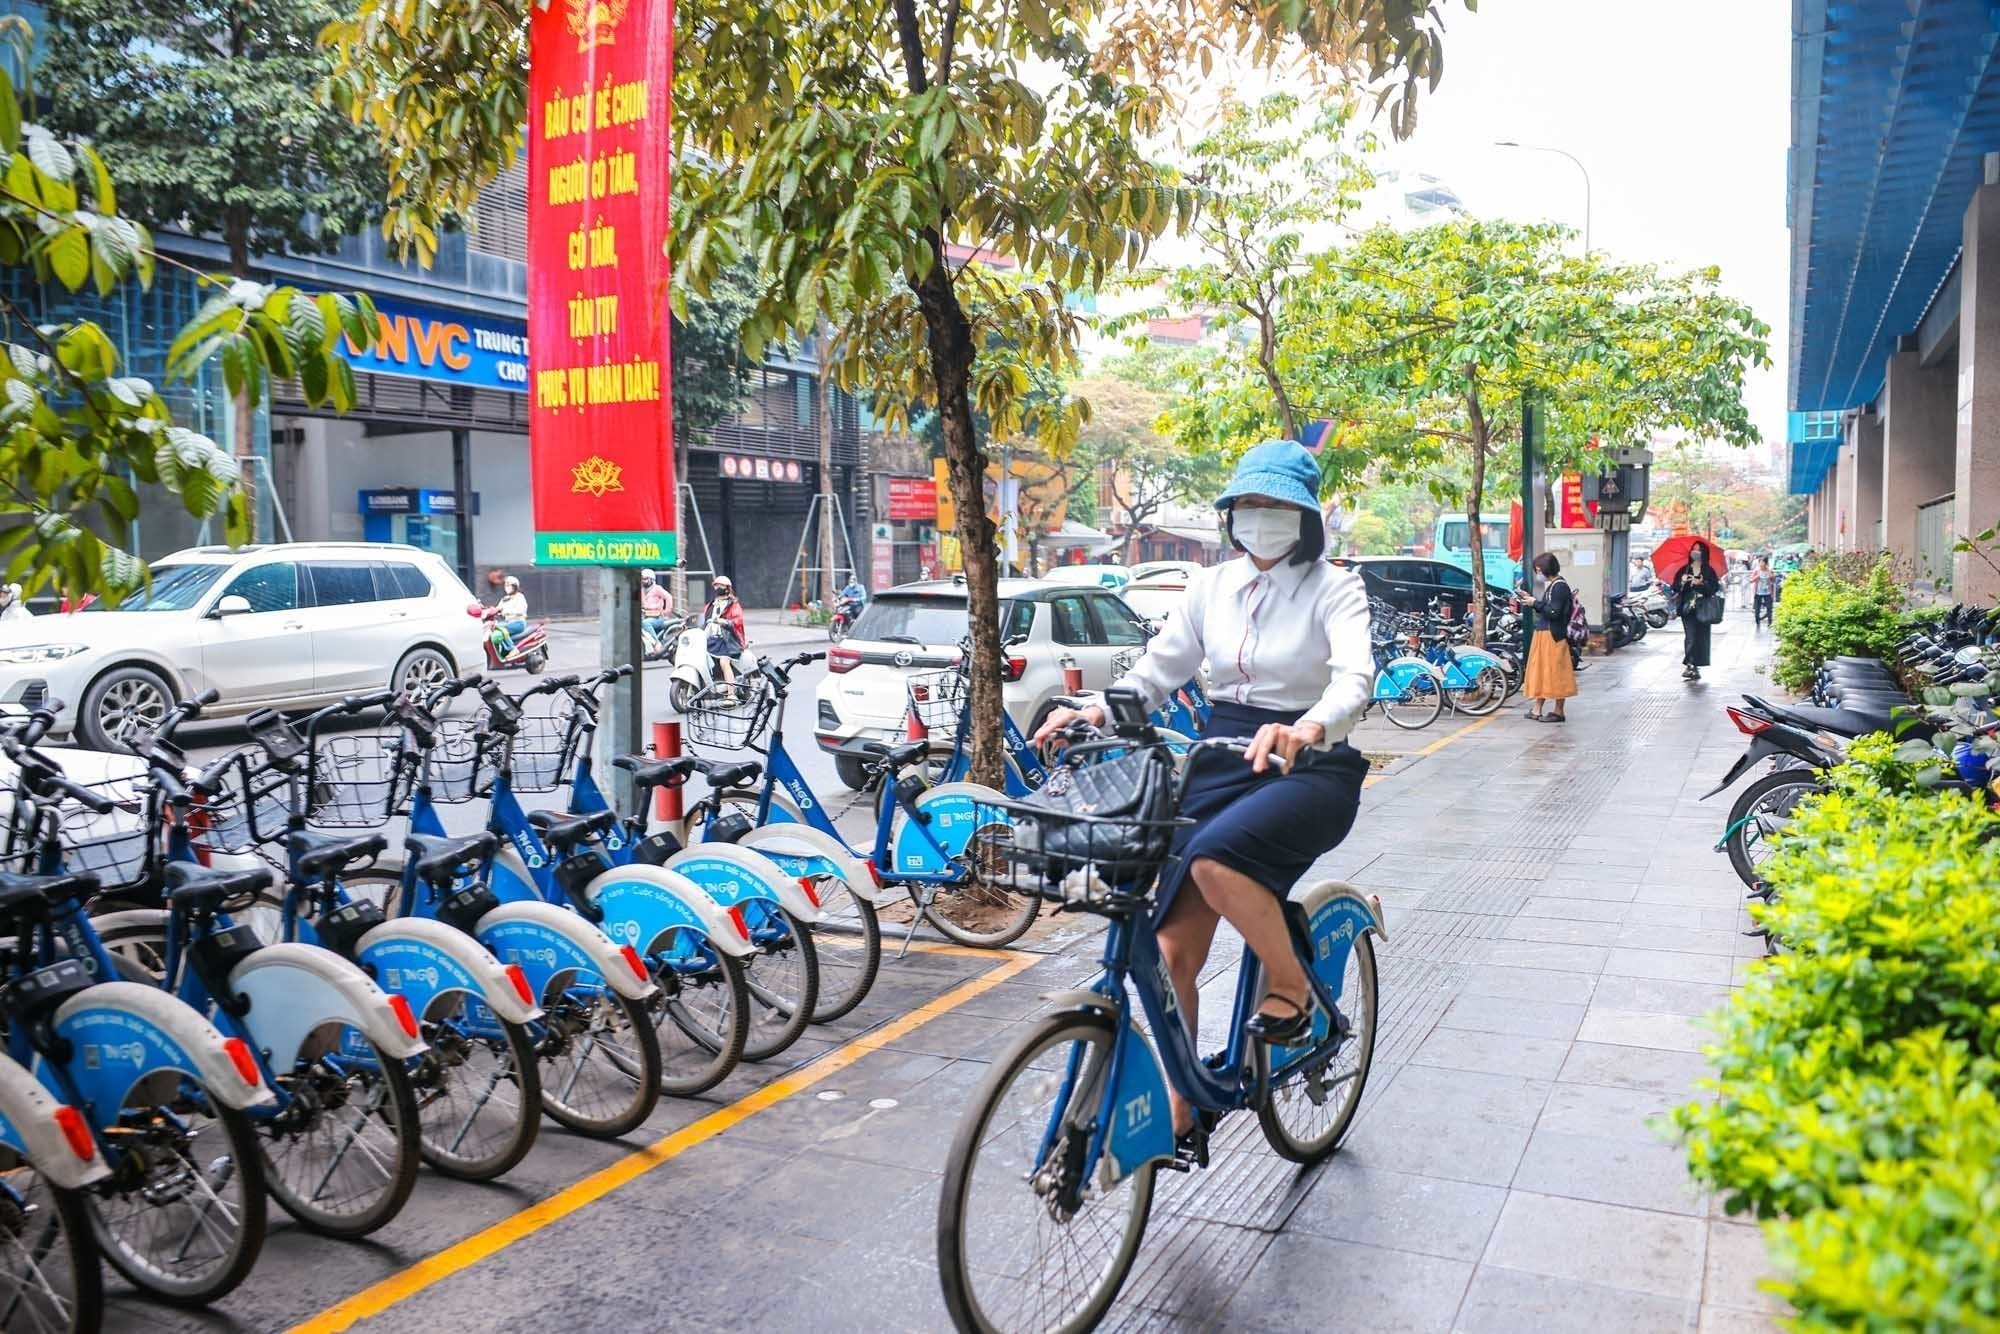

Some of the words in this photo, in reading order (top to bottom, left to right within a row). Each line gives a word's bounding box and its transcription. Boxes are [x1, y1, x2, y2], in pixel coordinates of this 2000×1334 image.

[544, 86, 570, 141] BẦU
[612, 79, 647, 130] CHỌN
[549, 153, 588, 206] NGƯỜI
[591, 150, 606, 200] CÓ
[568, 222, 586, 270] CÓ
[568, 291, 594, 346] TẬN
[473, 328, 521, 356] TRUNG
[497, 360, 527, 383] CHO
[537, 368, 568, 416] PHỤC
[569, 368, 586, 415] VỤ
[588, 358, 624, 405] NHÂN
[624, 353, 661, 403] DÂN!
[548, 539, 596, 560] PHƯỜNG
[597, 539, 606, 560] Ô
[607, 542, 634, 564] CHỢ
[634, 538, 662, 560] DỪA
[791, 778, 813, 809] TNGO
[517, 829, 543, 869] TNGO
[1124, 1089, 1152, 1128] TN
